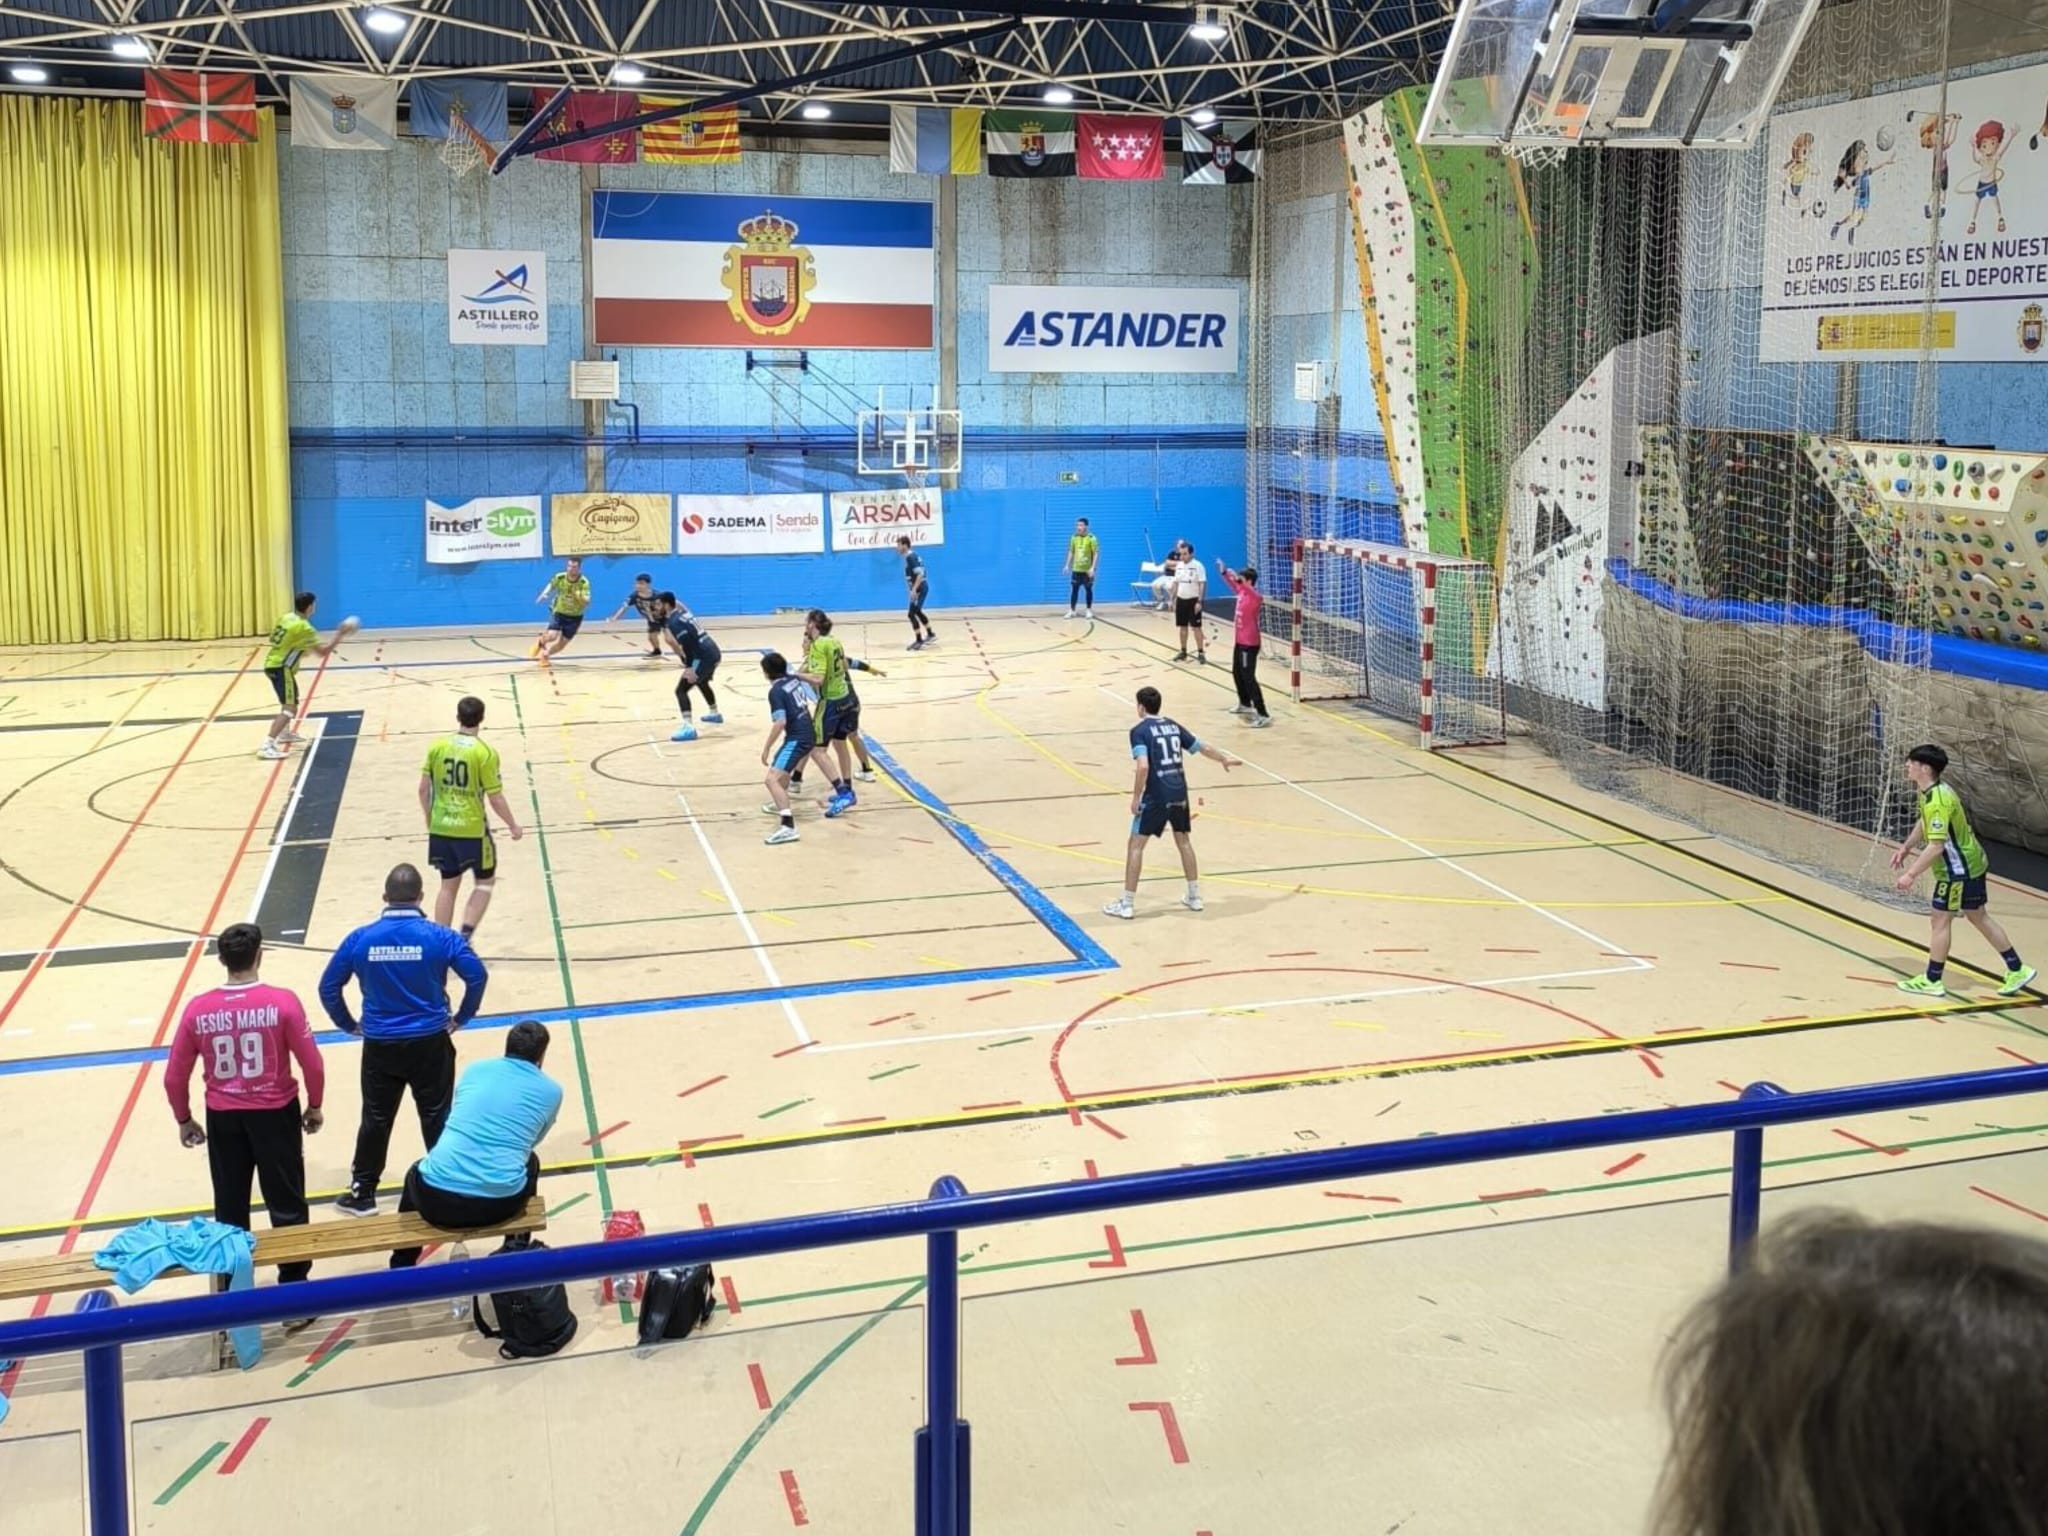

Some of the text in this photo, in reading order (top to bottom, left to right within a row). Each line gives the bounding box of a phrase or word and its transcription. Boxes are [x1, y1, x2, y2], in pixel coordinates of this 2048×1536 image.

[1787, 256, 1812, 274] LOS
[1816, 249, 1900, 272] PREJUICIOS
[1963, 242, 1986, 261] EN
[1941, 270, 1961, 288] EL
[1966, 264, 2048, 287] DEPORTE
[457, 309, 540, 321] ASTILLERO
[1003, 310, 1227, 349] ASTANDER
[707, 517, 767, 528] SADEMA
[776, 511, 819, 527] Senda
[844, 501, 931, 524] ARSAN
[1156, 735, 1181, 766] 19
[442, 757, 469, 788] 30
[1937, 881, 1948, 896] 8
[368, 945, 423, 954] ASTILLERO
[195, 1003, 279, 1035] JESÚS MARÍN
[211, 1031, 264, 1080] 89
